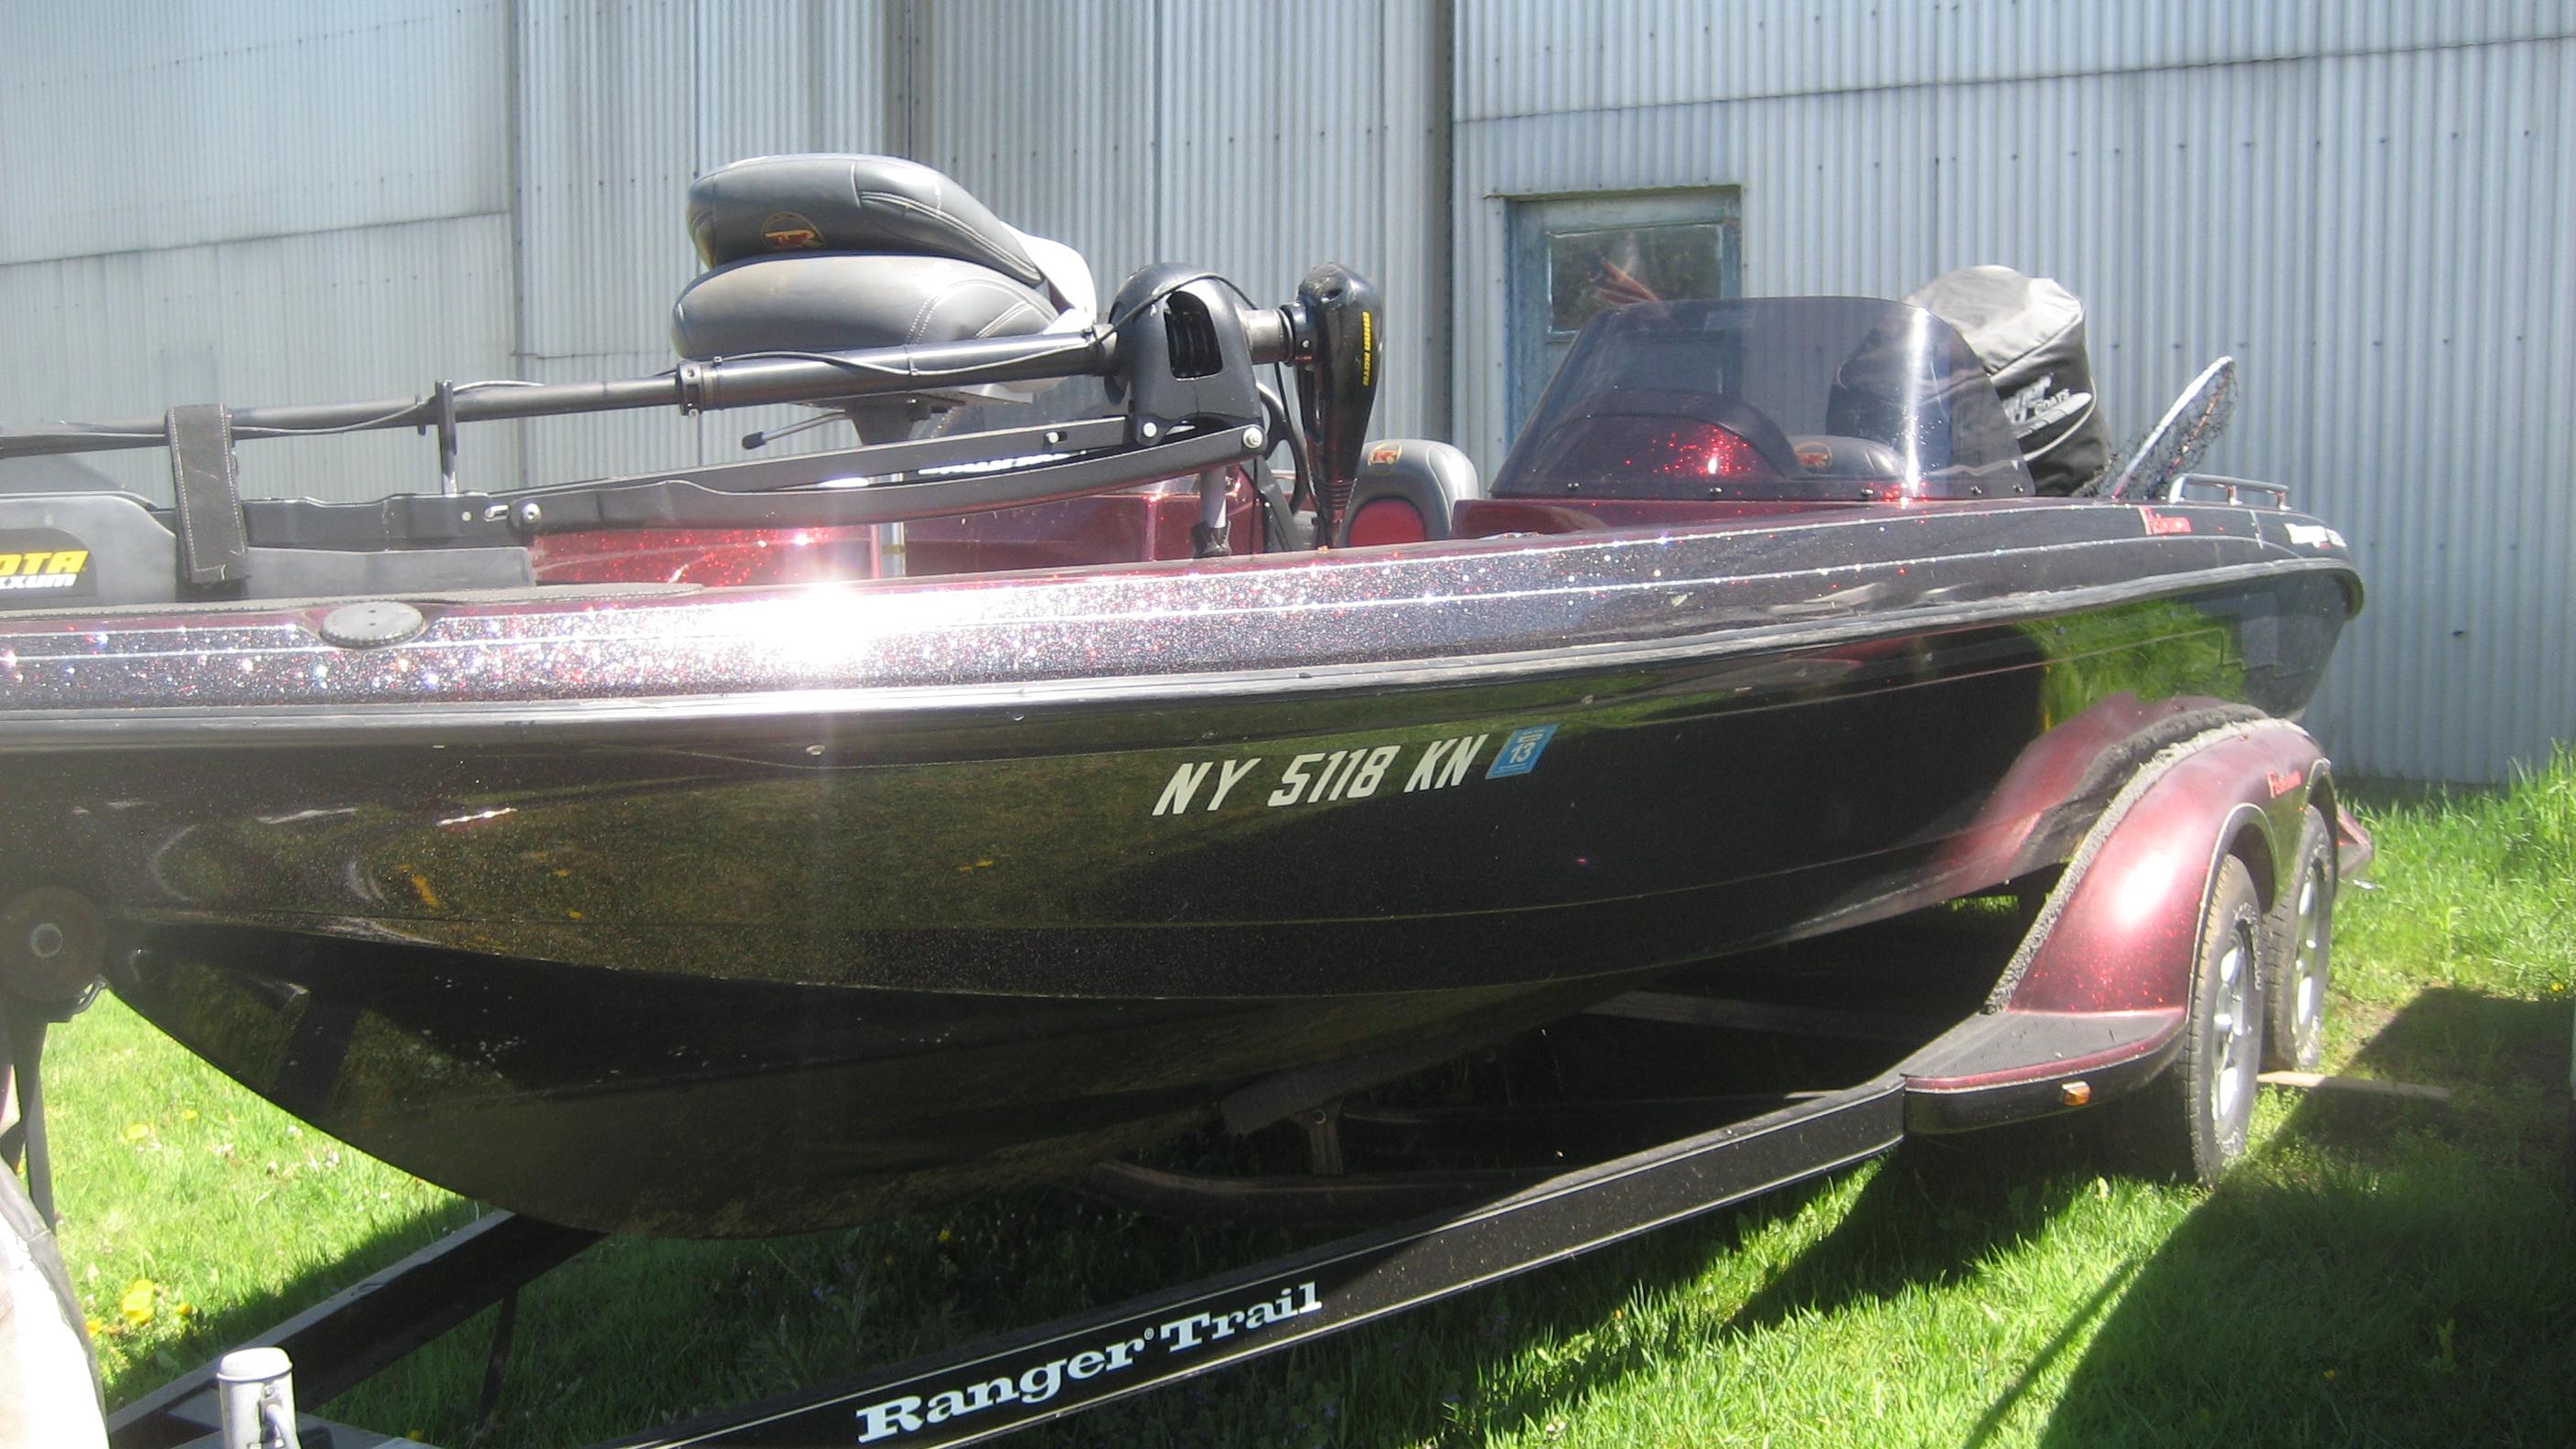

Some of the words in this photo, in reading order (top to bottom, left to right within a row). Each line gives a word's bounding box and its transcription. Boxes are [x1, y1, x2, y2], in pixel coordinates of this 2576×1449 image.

[1152, 757, 1262, 816] NY
[1267, 745, 1402, 807] 5118
[1402, 734, 1489, 793] KN
[1509, 741, 1536, 764] 13
[1160, 1281, 1324, 1354] Trail
